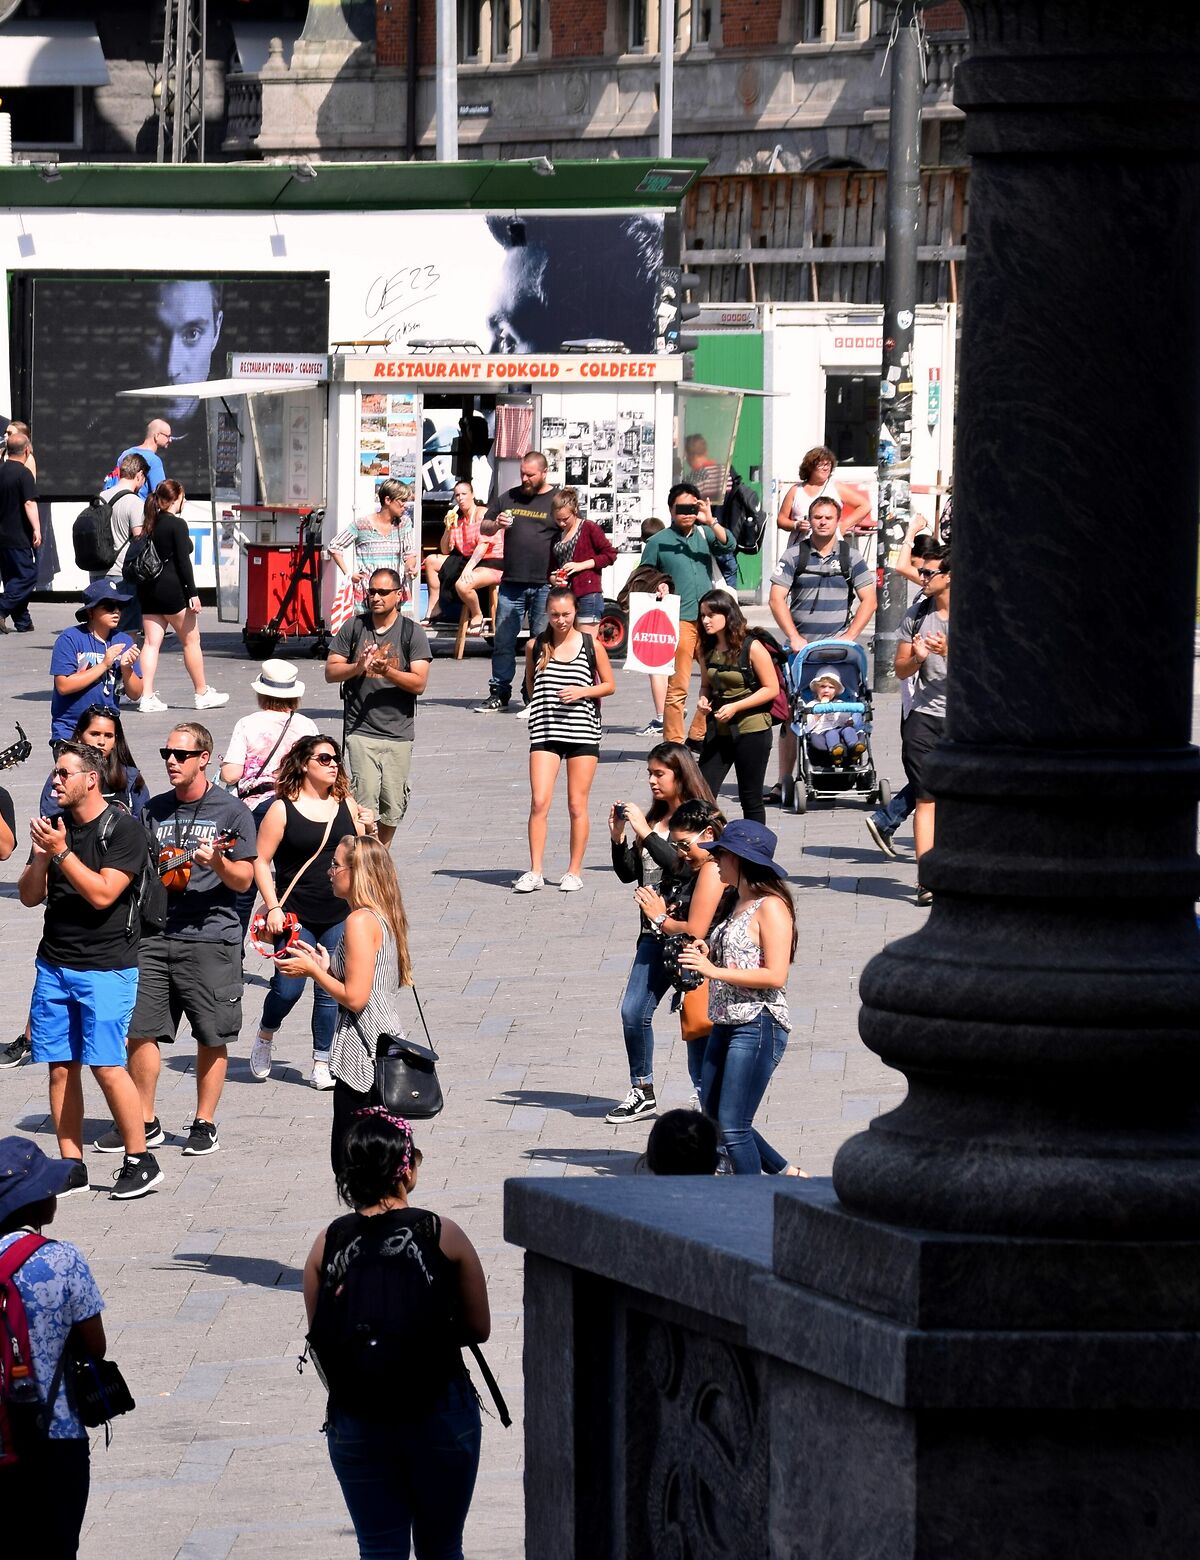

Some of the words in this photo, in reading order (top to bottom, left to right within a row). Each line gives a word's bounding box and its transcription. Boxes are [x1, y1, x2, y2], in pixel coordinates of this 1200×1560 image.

[239, 362, 271, 374] RESTAURANT
[272, 363, 294, 374] FODKOLD
[300, 363, 323, 374] COLDFEET
[374, 362, 482, 377] RESTAURANT
[486, 363, 560, 377] FODKOLD
[579, 362, 657, 377] COLDFEET
[633, 632, 676, 645] ARTIUM
